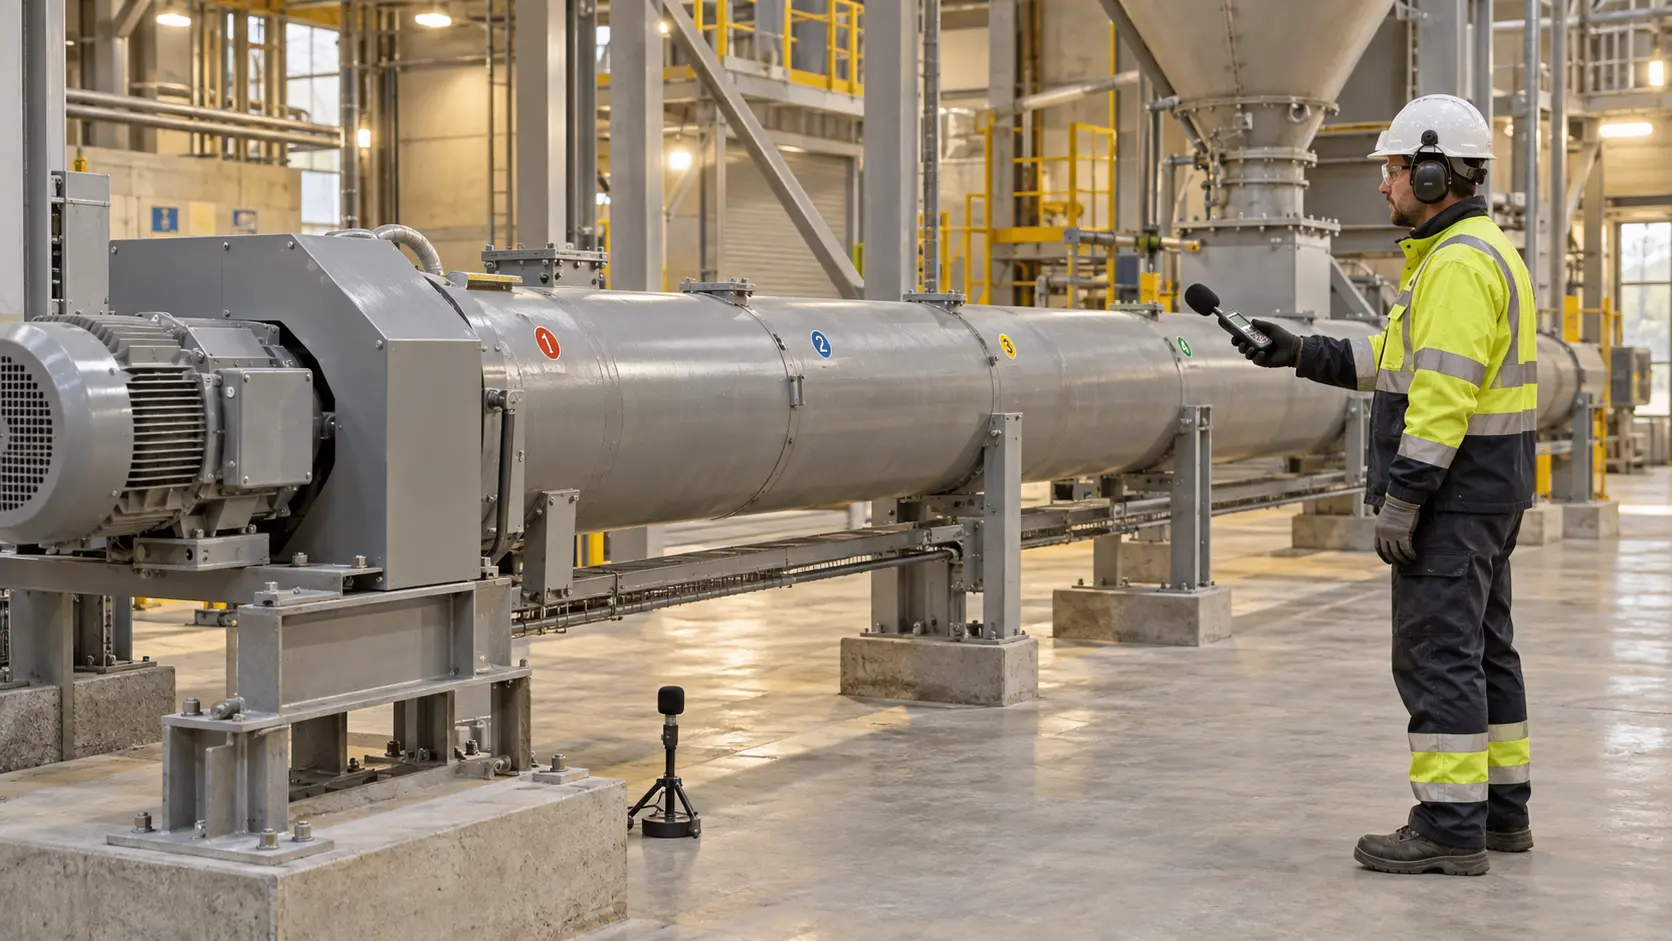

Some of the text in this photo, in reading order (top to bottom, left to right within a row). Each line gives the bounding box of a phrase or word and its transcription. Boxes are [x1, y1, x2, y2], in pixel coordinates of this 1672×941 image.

[541, 333, 554, 354] 1
[815, 335, 828, 353] 2
[1003, 338, 1013, 354] 3
